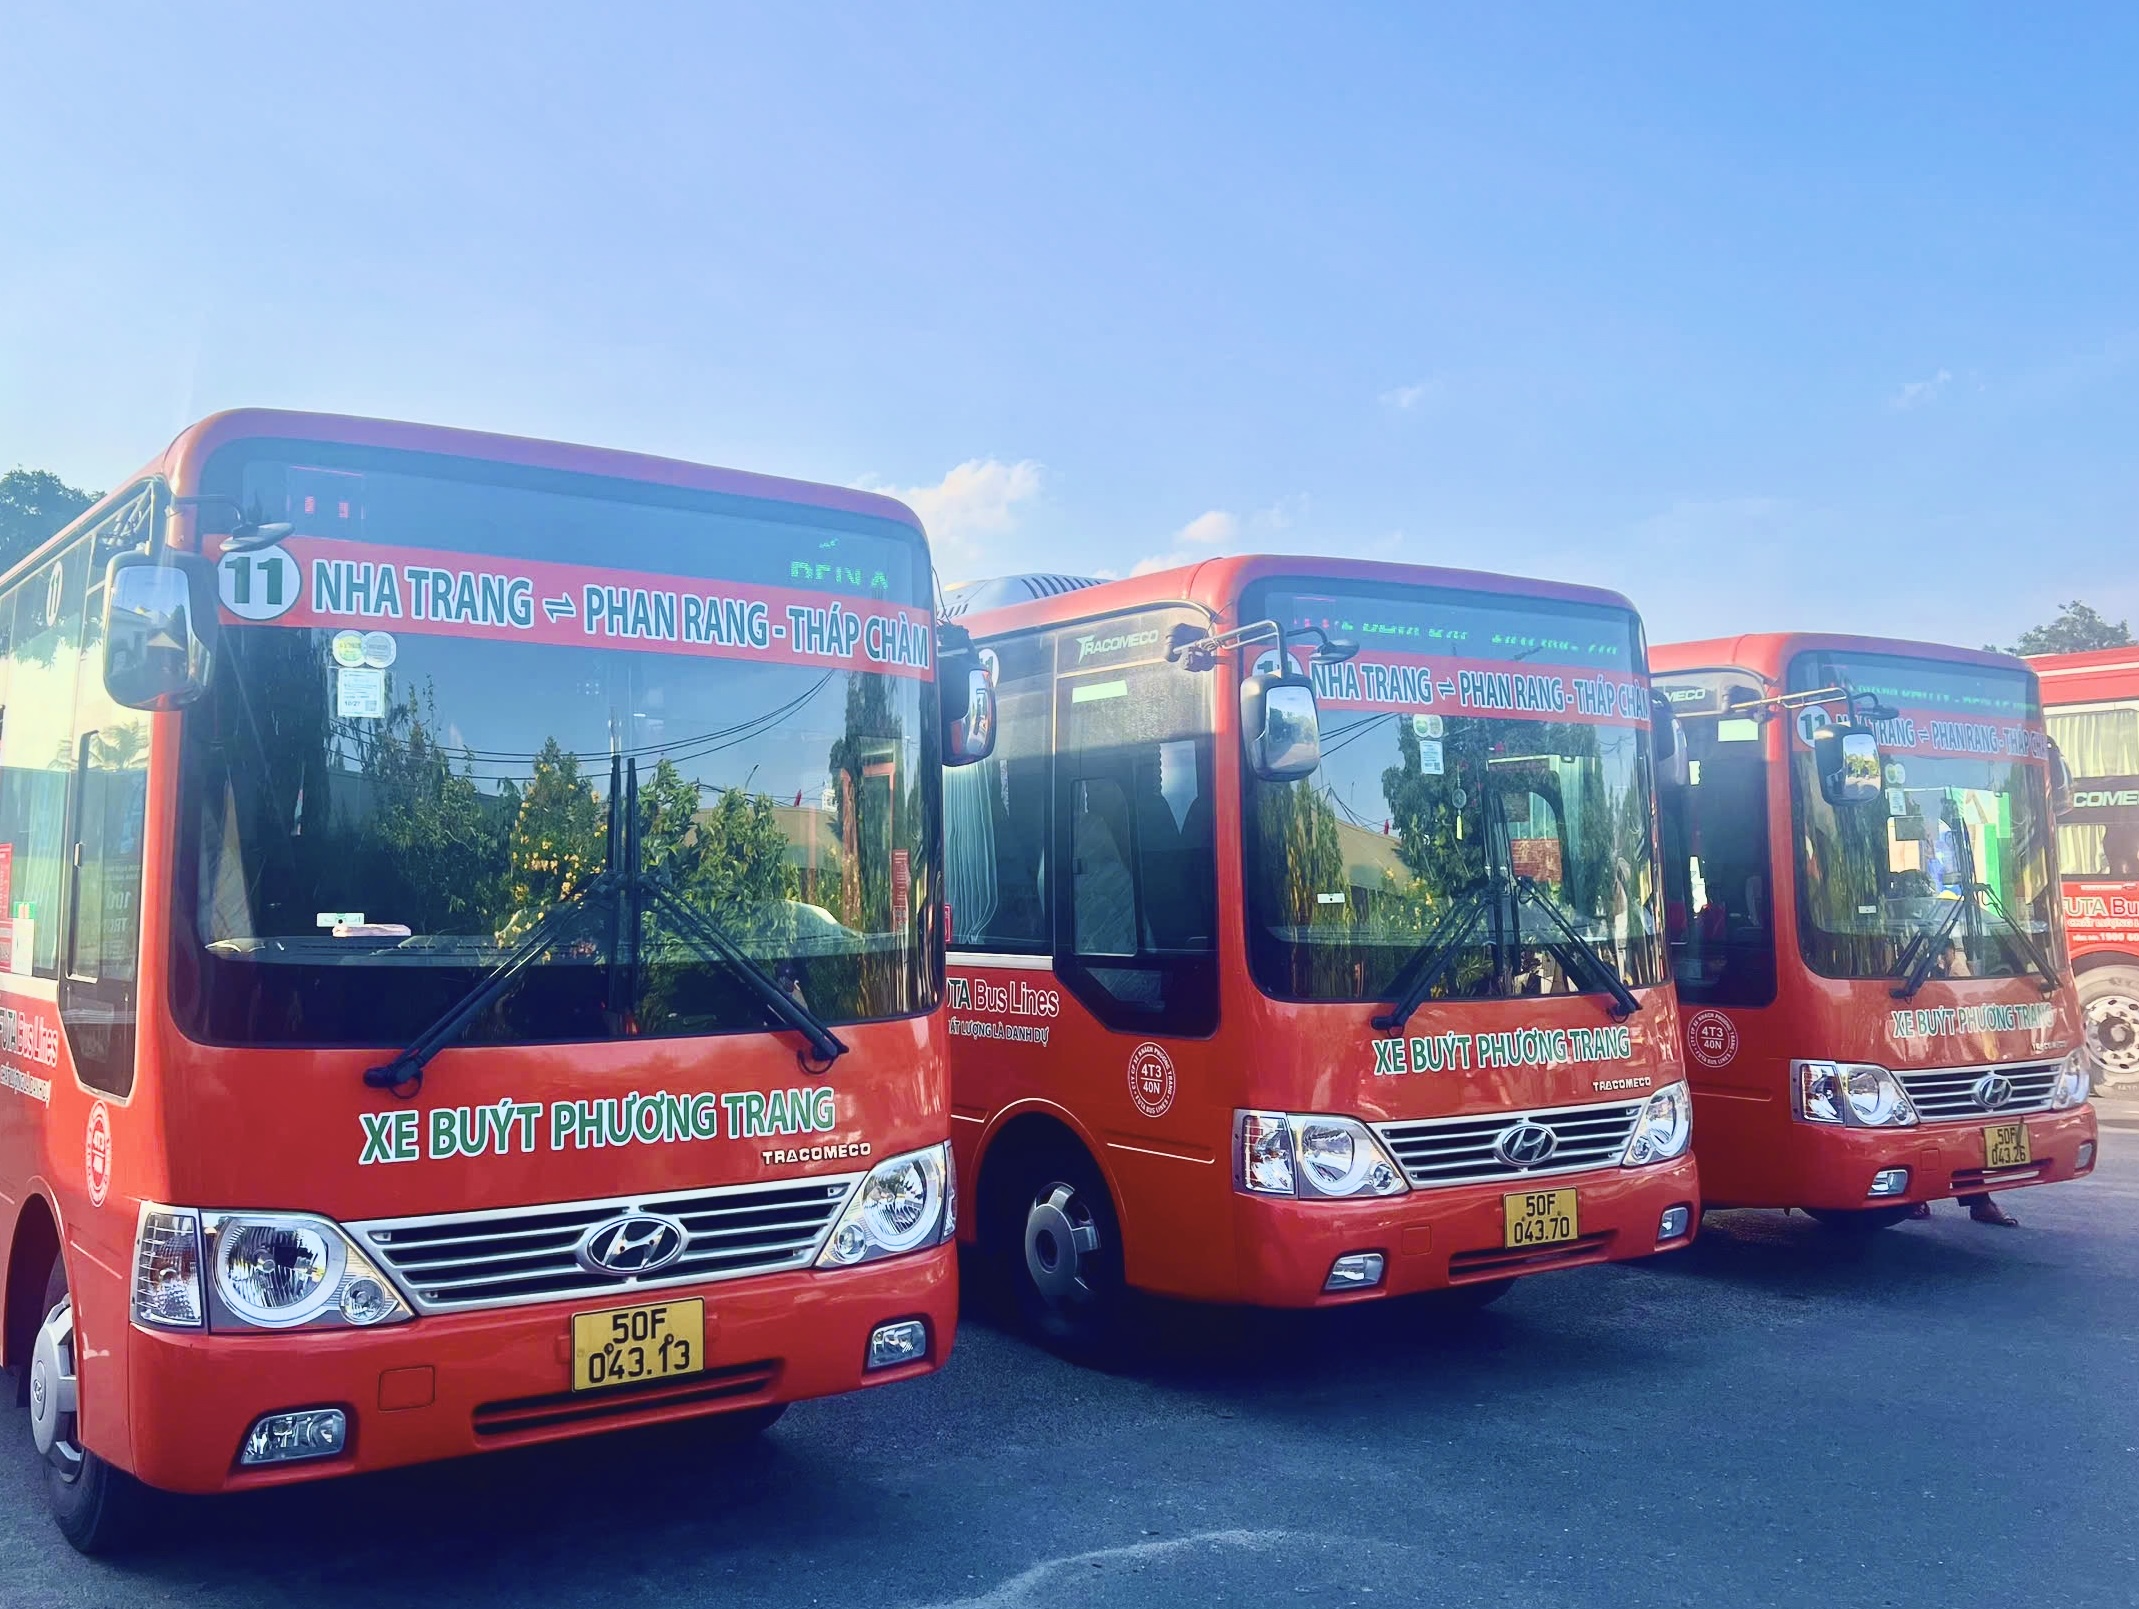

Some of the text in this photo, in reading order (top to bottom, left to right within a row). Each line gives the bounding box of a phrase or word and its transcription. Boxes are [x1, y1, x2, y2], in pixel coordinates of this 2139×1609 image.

[225, 557, 284, 605] 11
[312, 559, 402, 620] NHA
[405, 565, 534, 629] TRANG
[584, 584, 678, 641] PHAN
[682, 594, 769, 650] RANG
[786, 601, 861, 659] THÁP
[864, 612, 930, 669] CHÀM
[1076, 629, 1159, 664] TRACOMECO
[1310, 661, 1361, 700] NHA
[1360, 663, 1433, 704] TRANG
[1458, 670, 1513, 710] PHAN
[1513, 674, 1565, 713] RANG
[1573, 675, 1616, 716] THÁP
[1871, 718, 1916, 748] TRANG
[1931, 720, 1966, 752] PHAN
[1966, 723, 1998, 754] RANG
[2003, 723, 2029, 757] THÁP
[946, 977, 1059, 1018] TA Bus Lines
[961, 1019, 992, 1040] LƯỢNG
[992, 1020, 1005, 1040] LÀ
[1005, 1024, 1033, 1042] DANH
[1033, 1026, 1050, 1048] DỰ
[1701, 1026, 1723, 1037] 4T3
[1892, 1010, 1914, 1038] XE
[1916, 1005, 1955, 1038] BUÝT
[1958, 1003, 2014, 1034] PHƯƠNG
[1372, 1026, 1631, 1076] XE BUÝT PHƯƠNG TRANG
[1704, 1040, 1722, 1049] 40N
[1141, 1063, 1162, 1079] 4T3
[1143, 1081, 1160, 1095] 40N
[1592, 1076, 1652, 1092] TRACOMECO
[358, 1086, 835, 1165] XE BUÝT PHƯƠNG TRANG
[1996, 1127, 2015, 1145] 50F
[762, 1142, 871, 1165] TRACOMECO
[1526, 1193, 1556, 1217] 50F
[1514, 1216, 1569, 1243] 043.70
[612, 1307, 667, 1344] 50F
[589, 1337, 690, 1384] 043.13
